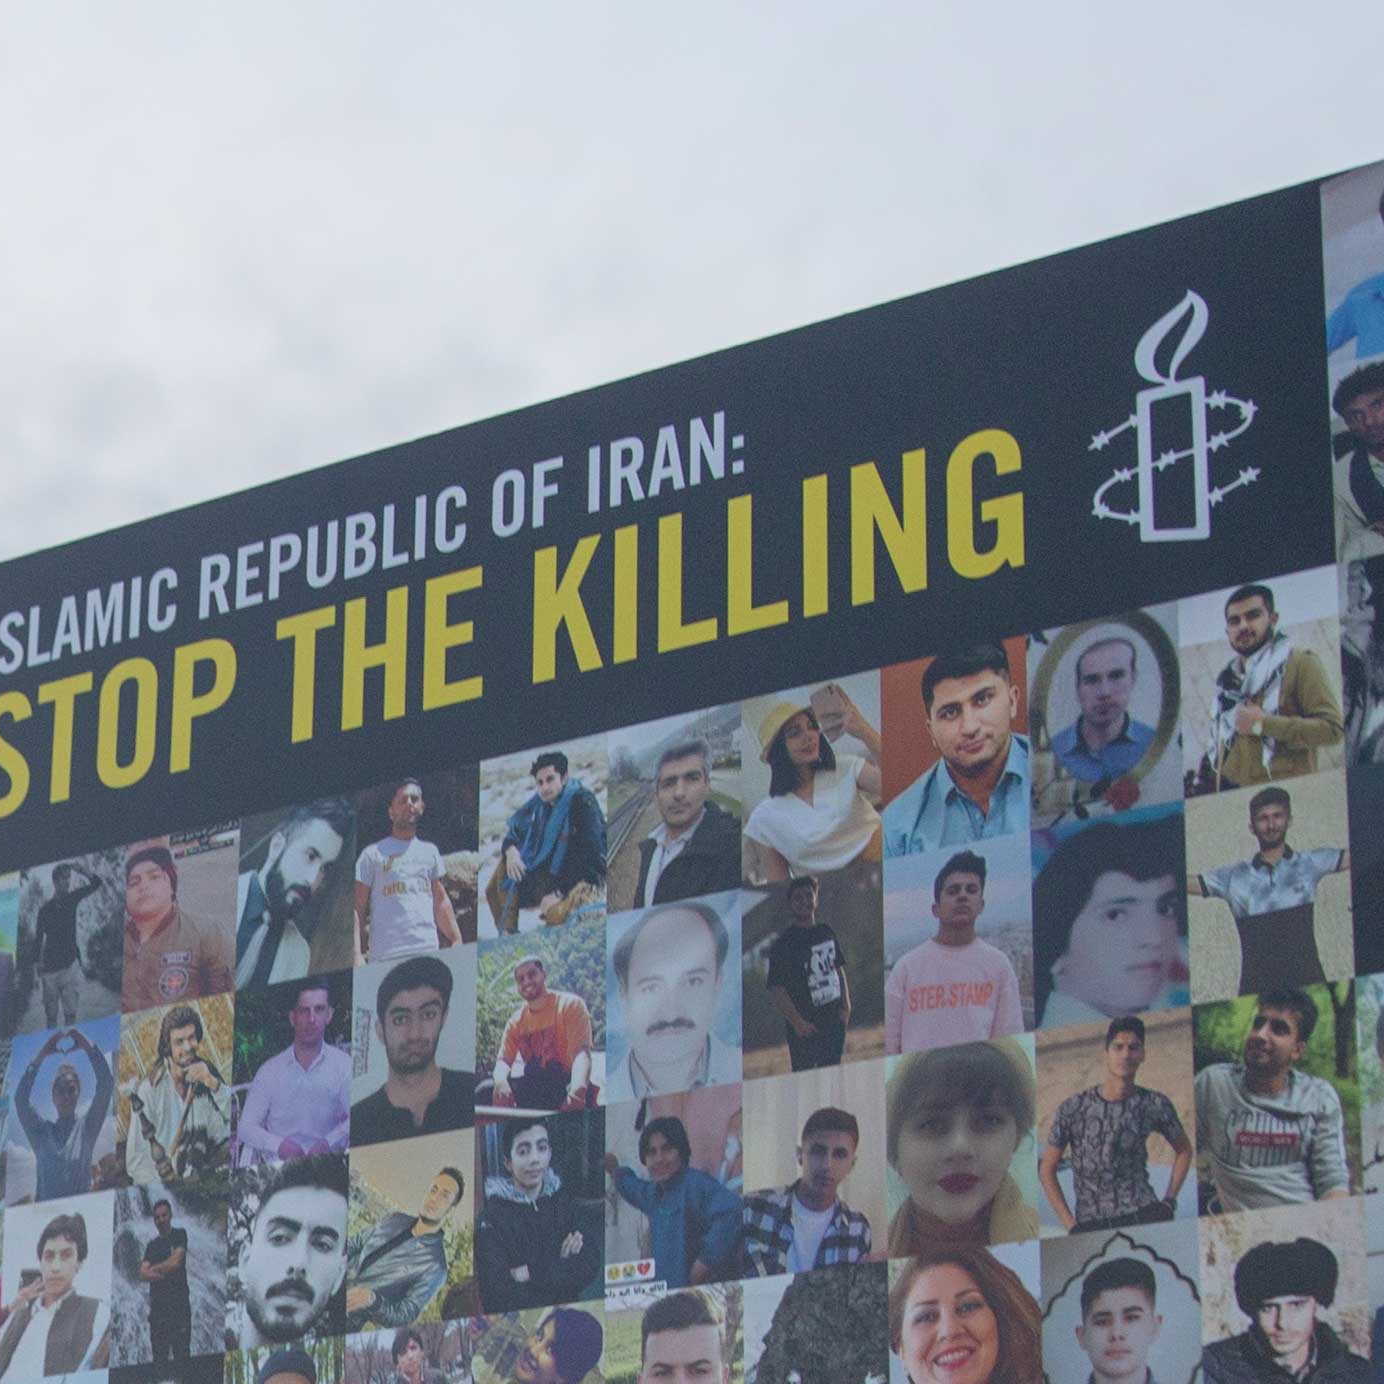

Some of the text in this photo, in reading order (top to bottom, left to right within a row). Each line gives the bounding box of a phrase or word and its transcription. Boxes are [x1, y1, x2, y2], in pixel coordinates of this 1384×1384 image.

[198, 485, 467, 621] REPUBLIC
[490, 455, 564, 537] OF
[587, 410, 745, 514] IRAN:
[275, 566, 484, 744] THE
[531, 428, 1026, 684] KILLING
